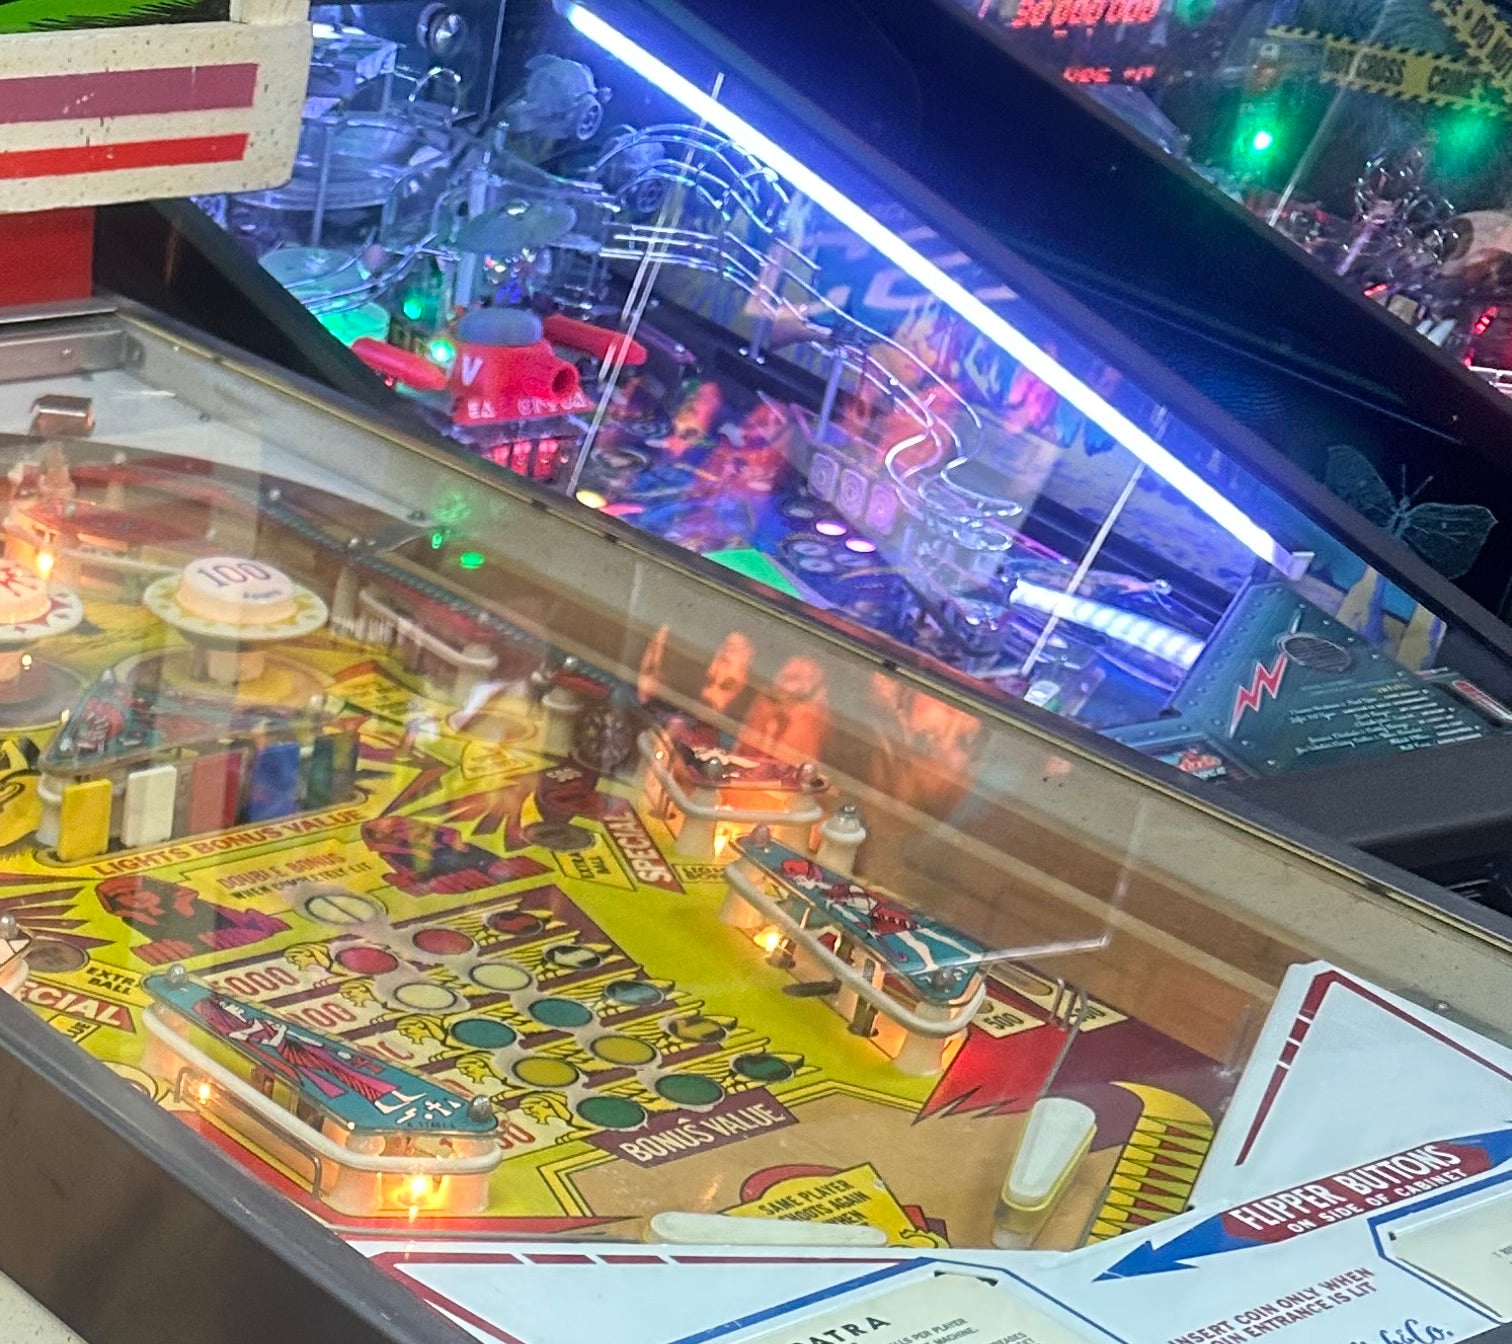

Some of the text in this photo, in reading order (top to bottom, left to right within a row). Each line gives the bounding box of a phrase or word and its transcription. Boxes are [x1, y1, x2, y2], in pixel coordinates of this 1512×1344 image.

[196, 562, 271, 588] 100
[91, 808, 370, 877] LIGHTS BONUS VALUE
[87, 977, 132, 996] BALL
[985, 1012, 1025, 1031] 500
[619, 1103, 787, 1163] BONUS VALUE
[758, 1179, 855, 1216] SAME PLAYER
[828, 1190, 872, 1211] AGAIN
[1232, 1143, 1463, 1232] FLIPPER BUTTONS
[1286, 1166, 1468, 1236] ON SIDE OF CABINET
[1232, 1301, 1280, 1328] COIN
[1274, 1285, 1322, 1315] ONLY
[1319, 1266, 1377, 1300] WHEN
[1243, 1302, 1333, 1340] ENTRANCE
[1330, 1292, 1352, 1310] IS
[1347, 1280, 1379, 1302] LIT
[910, 1330, 933, 1340] PER
[930, 1317, 968, 1333] PLAYER
